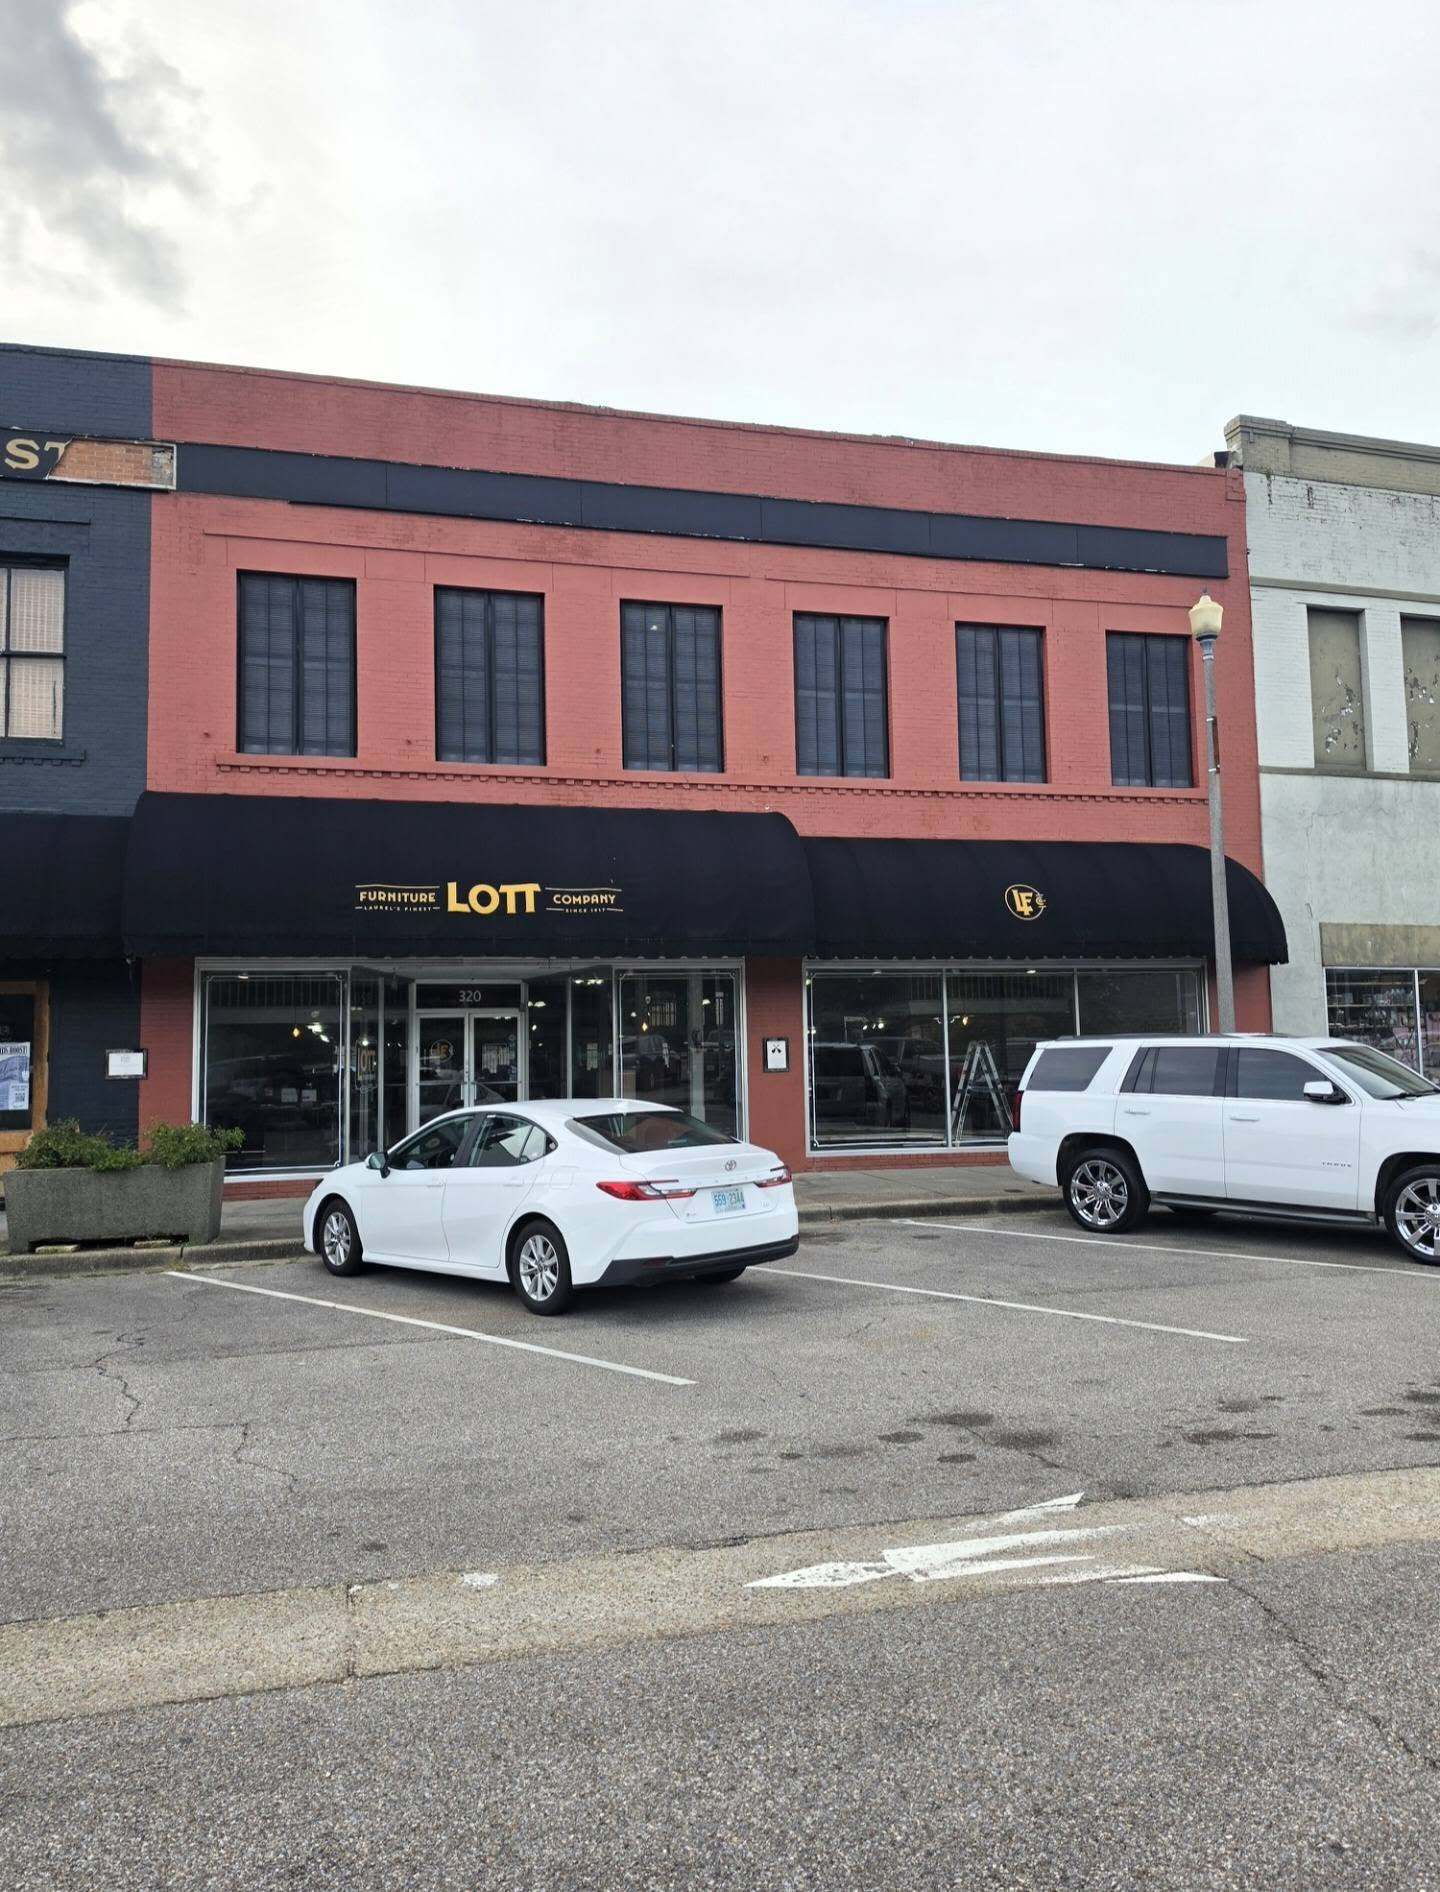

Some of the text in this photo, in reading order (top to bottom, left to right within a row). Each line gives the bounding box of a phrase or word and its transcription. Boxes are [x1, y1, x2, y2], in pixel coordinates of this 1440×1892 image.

[359, 890, 436, 903] FURNITURE
[447, 881, 541, 914] LOTT
[553, 893, 616, 905] COMPANY
[363, 904, 401, 912] LAUREL'S
[458, 990, 482, 1002] 320
